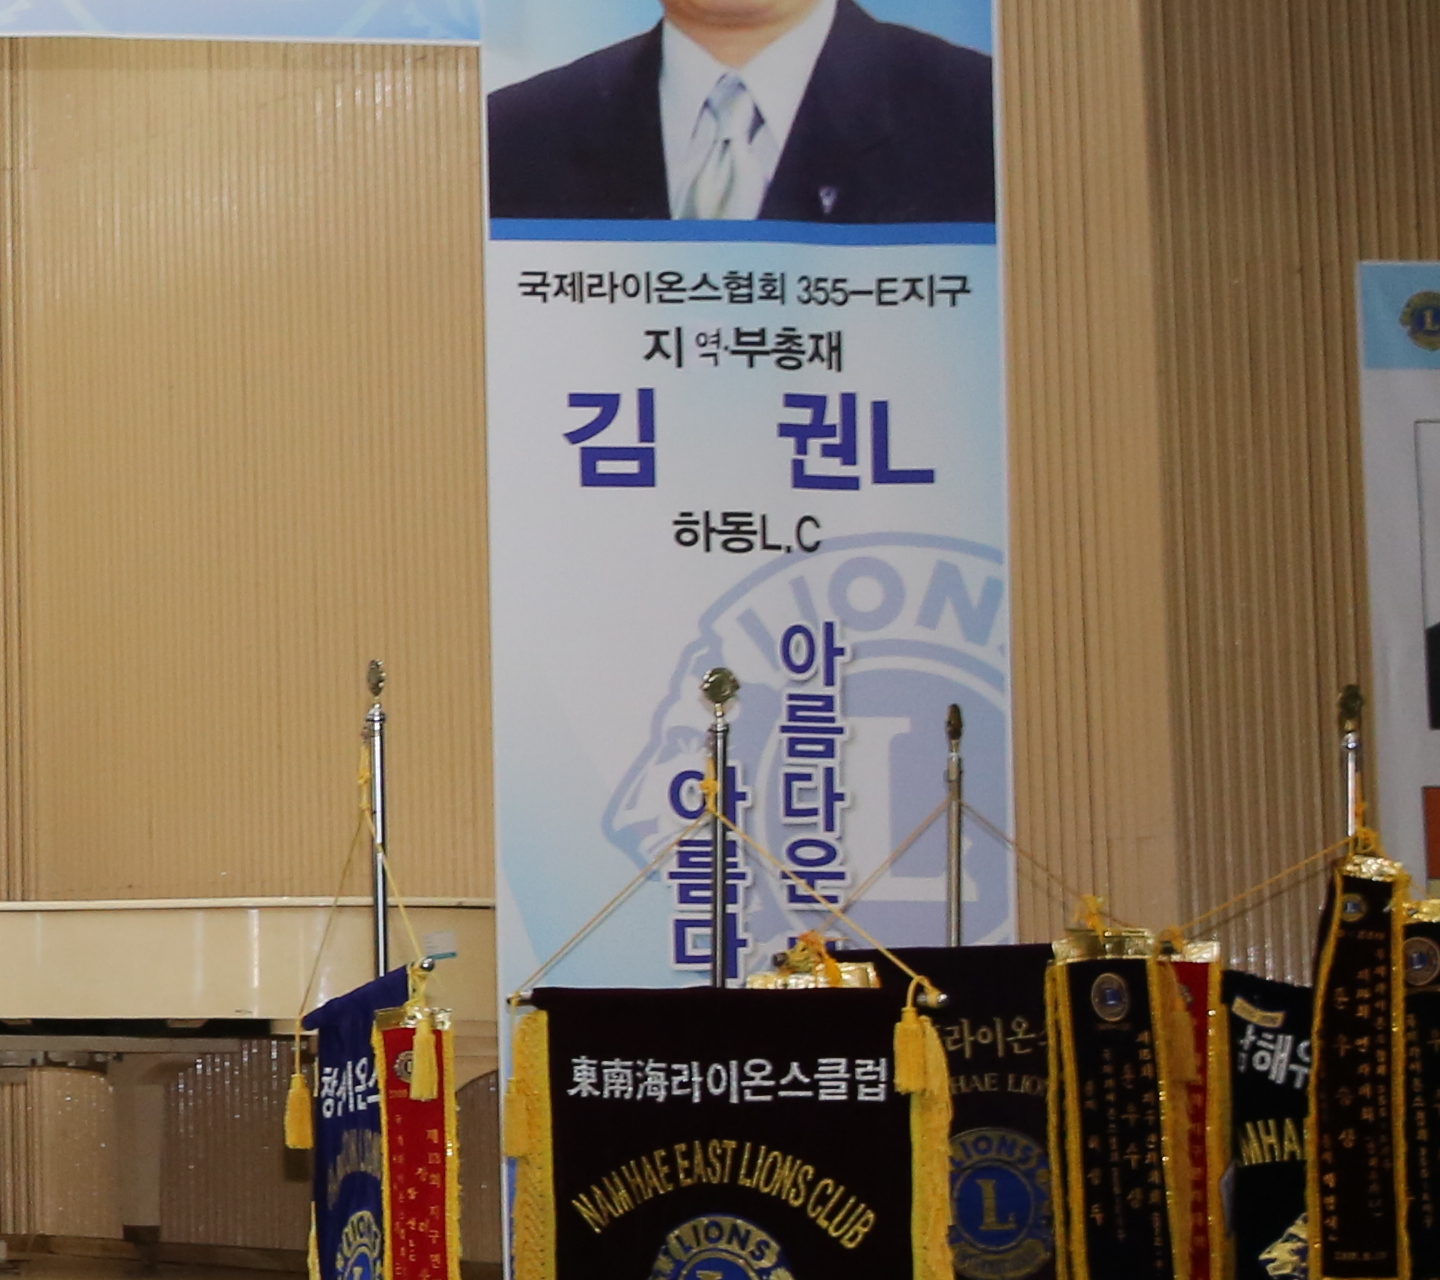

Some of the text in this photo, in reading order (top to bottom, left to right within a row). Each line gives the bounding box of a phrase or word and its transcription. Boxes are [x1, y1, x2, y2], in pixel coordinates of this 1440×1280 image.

[517, 270, 972, 309] 국제라이온스협회 355-E지구
[562, 387, 657, 488] 김
[673, 510, 822, 554] 하동L.C
[567, 1055, 888, 1104] 東南海라이온스클럽
[679, 1139, 739, 1189] EAST
[738, 1141, 814, 1208] LIONS
[807, 1177, 875, 1250] CLUB
[677, 1221, 772, 1262] LIONS
